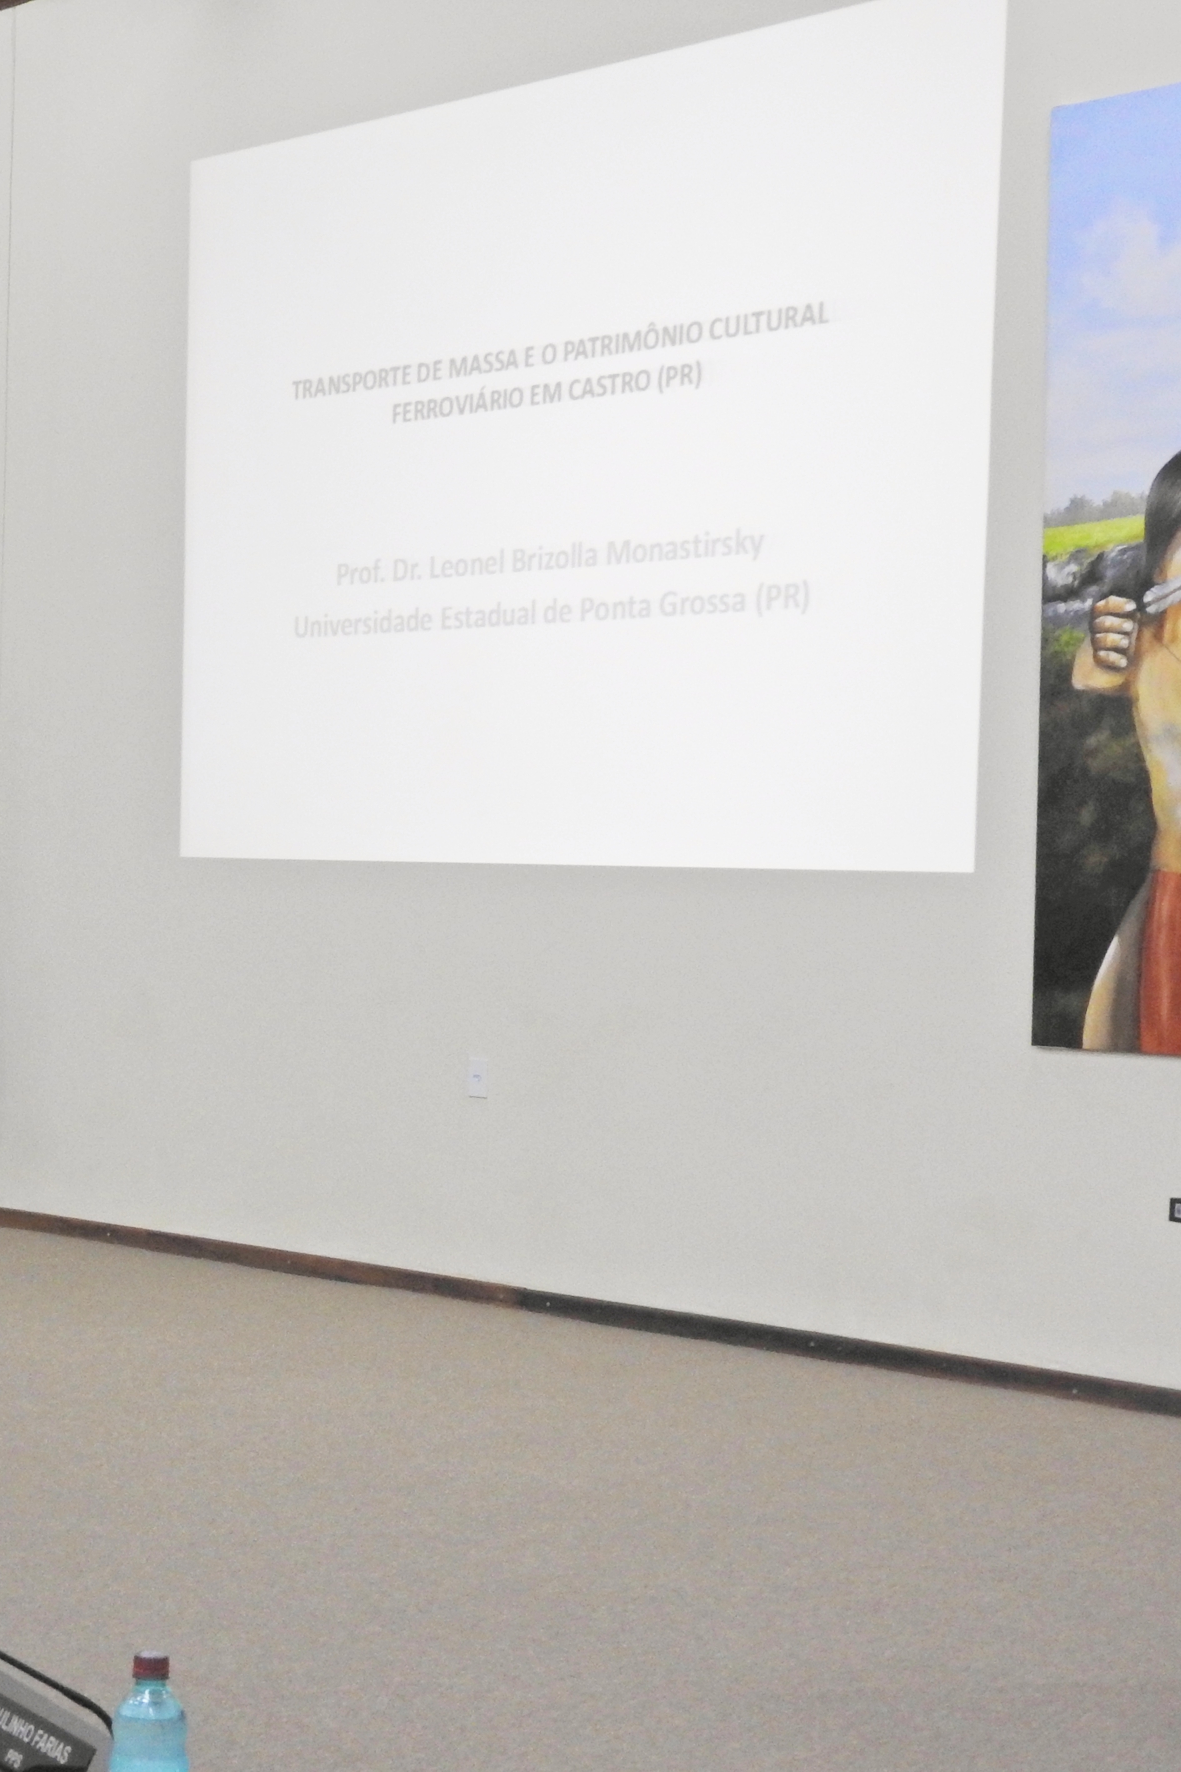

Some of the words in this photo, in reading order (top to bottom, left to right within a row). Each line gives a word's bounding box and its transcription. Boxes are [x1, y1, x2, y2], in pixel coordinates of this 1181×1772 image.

[291, 364, 412, 400] TRANSPORTE
[416, 359, 443, 384] DE
[448, 348, 519, 379] MASSA
[524, 345, 535, 368] E
[541, 342, 558, 365] O
[563, 320, 704, 362] PATRIMÔNIO
[708, 301, 830, 341] CULTURAL
[392, 386, 525, 424] FERROVIÁRIO
[529, 381, 563, 407] EM
[567, 369, 652, 401] CASTRO
[657, 360, 703, 395] (PR)
[336, 557, 386, 586] Prof.
[392, 557, 423, 583] Dr.
[429, 547, 506, 580] Leonel
[511, 540, 599, 574] Brizolla
[605, 527, 766, 566] Monastirsky
[293, 606, 434, 639] Universidade
[440, 598, 537, 631] Estadual
[542, 597, 574, 625] de
[579, 595, 653, 623] Ponta
[658, 590, 747, 618] Grossa
[754, 578, 811, 618] (PR)
[30, 1729, 73, 1765] FARIAS
